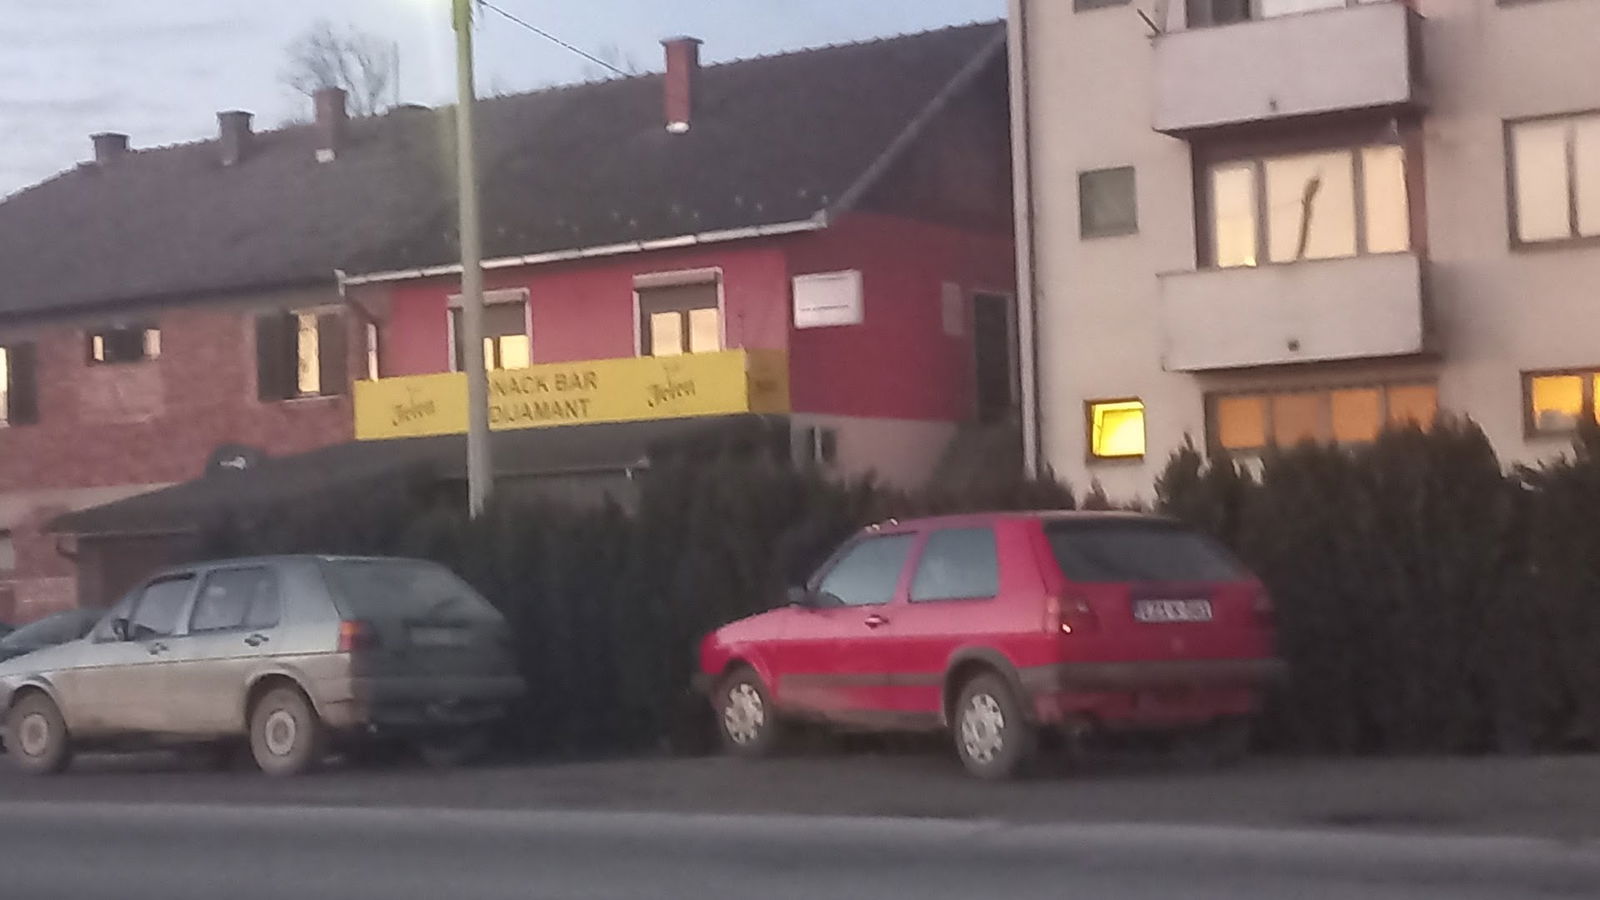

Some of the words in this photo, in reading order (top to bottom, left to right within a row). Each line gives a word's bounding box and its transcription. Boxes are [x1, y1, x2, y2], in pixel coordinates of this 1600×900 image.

[487, 376, 549, 396] NACK
[554, 371, 598, 392] BAR
[489, 398, 589, 423] DIJAMANT
